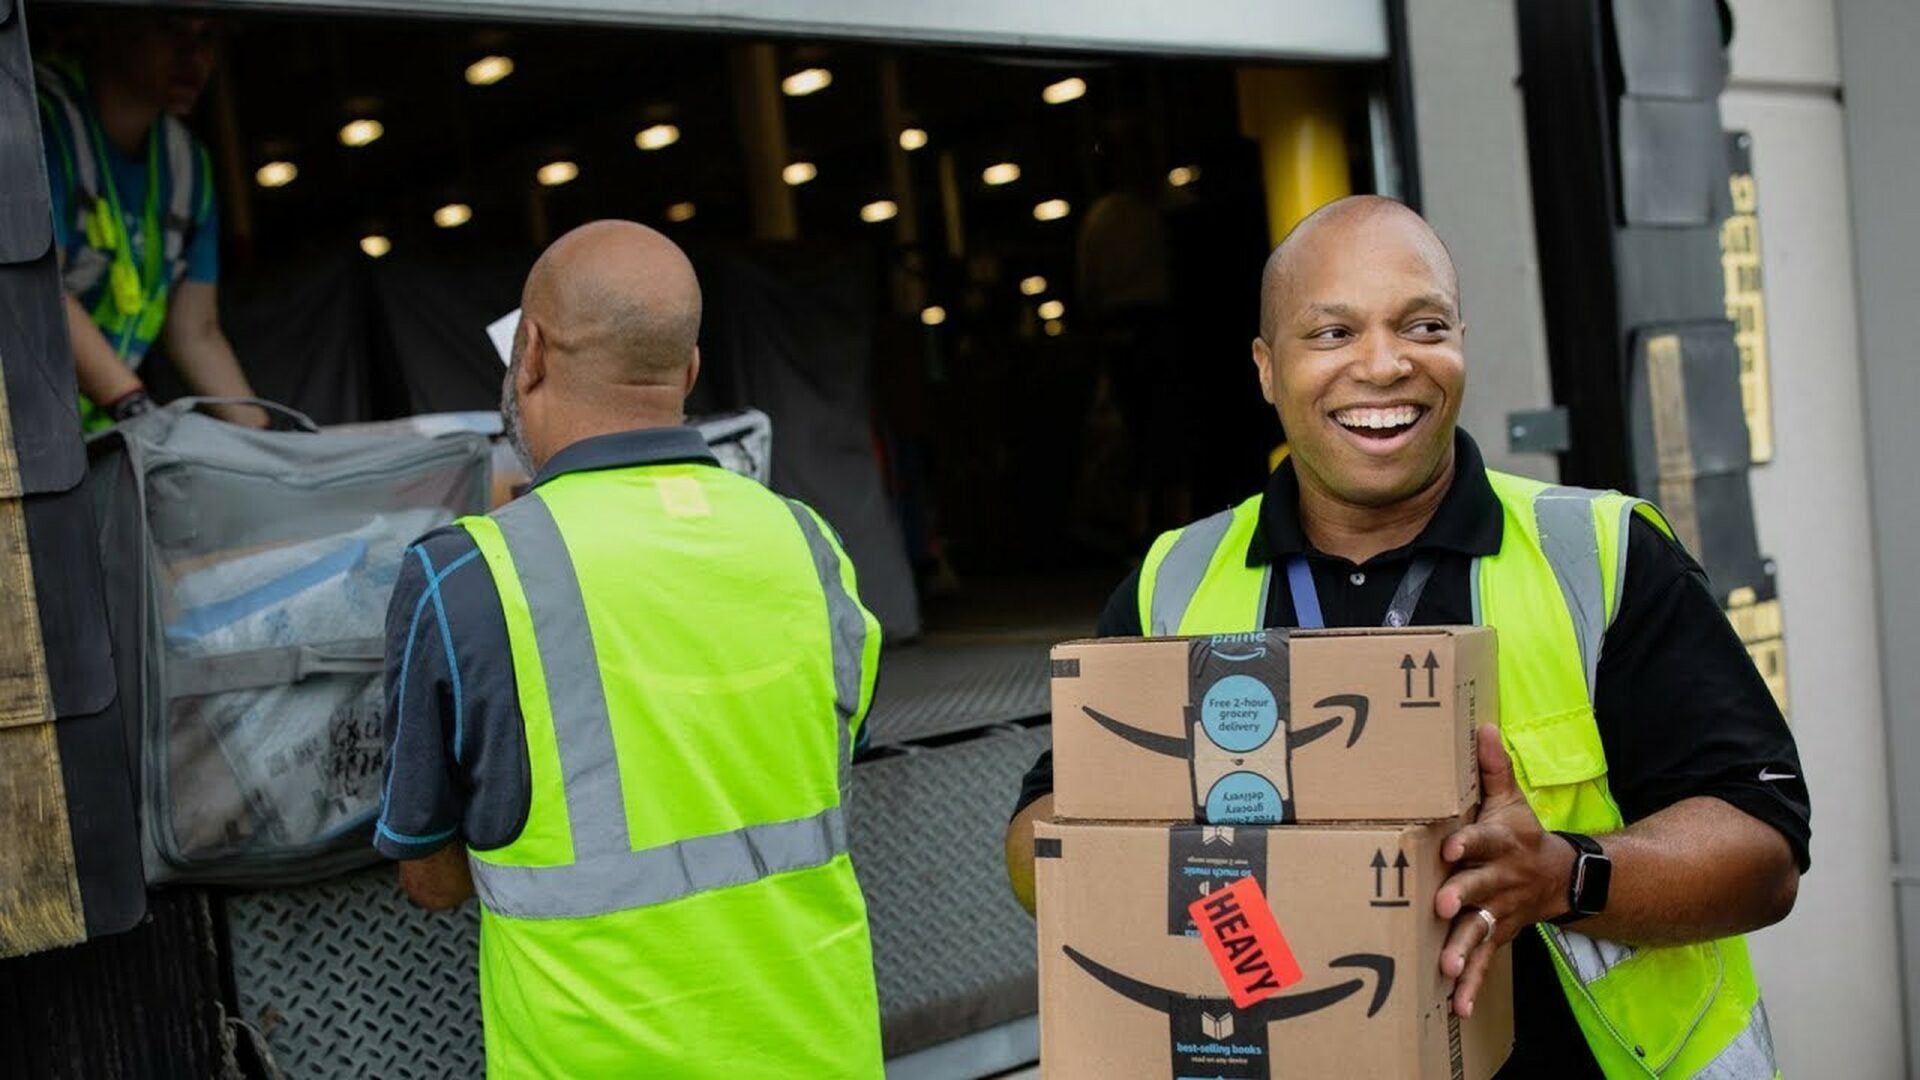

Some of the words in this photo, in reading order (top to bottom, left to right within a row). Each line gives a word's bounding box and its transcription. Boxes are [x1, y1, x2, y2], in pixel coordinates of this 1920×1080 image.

[1209, 698, 1231, 708] Free
[1233, 697, 1269, 708] 2-hour
[1219, 708, 1259, 720] grocery
[1218, 720, 1260, 733] delivery
[1223, 791, 1264, 803] delivery
[1225, 803, 1264, 814] grocery
[1183, 867, 1211, 877] music
[1212, 868, 1240, 878] much
[1203, 892, 1280, 995] HEAVY
[1176, 1042, 1231, 1056] best-selling
[1231, 1043, 1262, 1055] books
